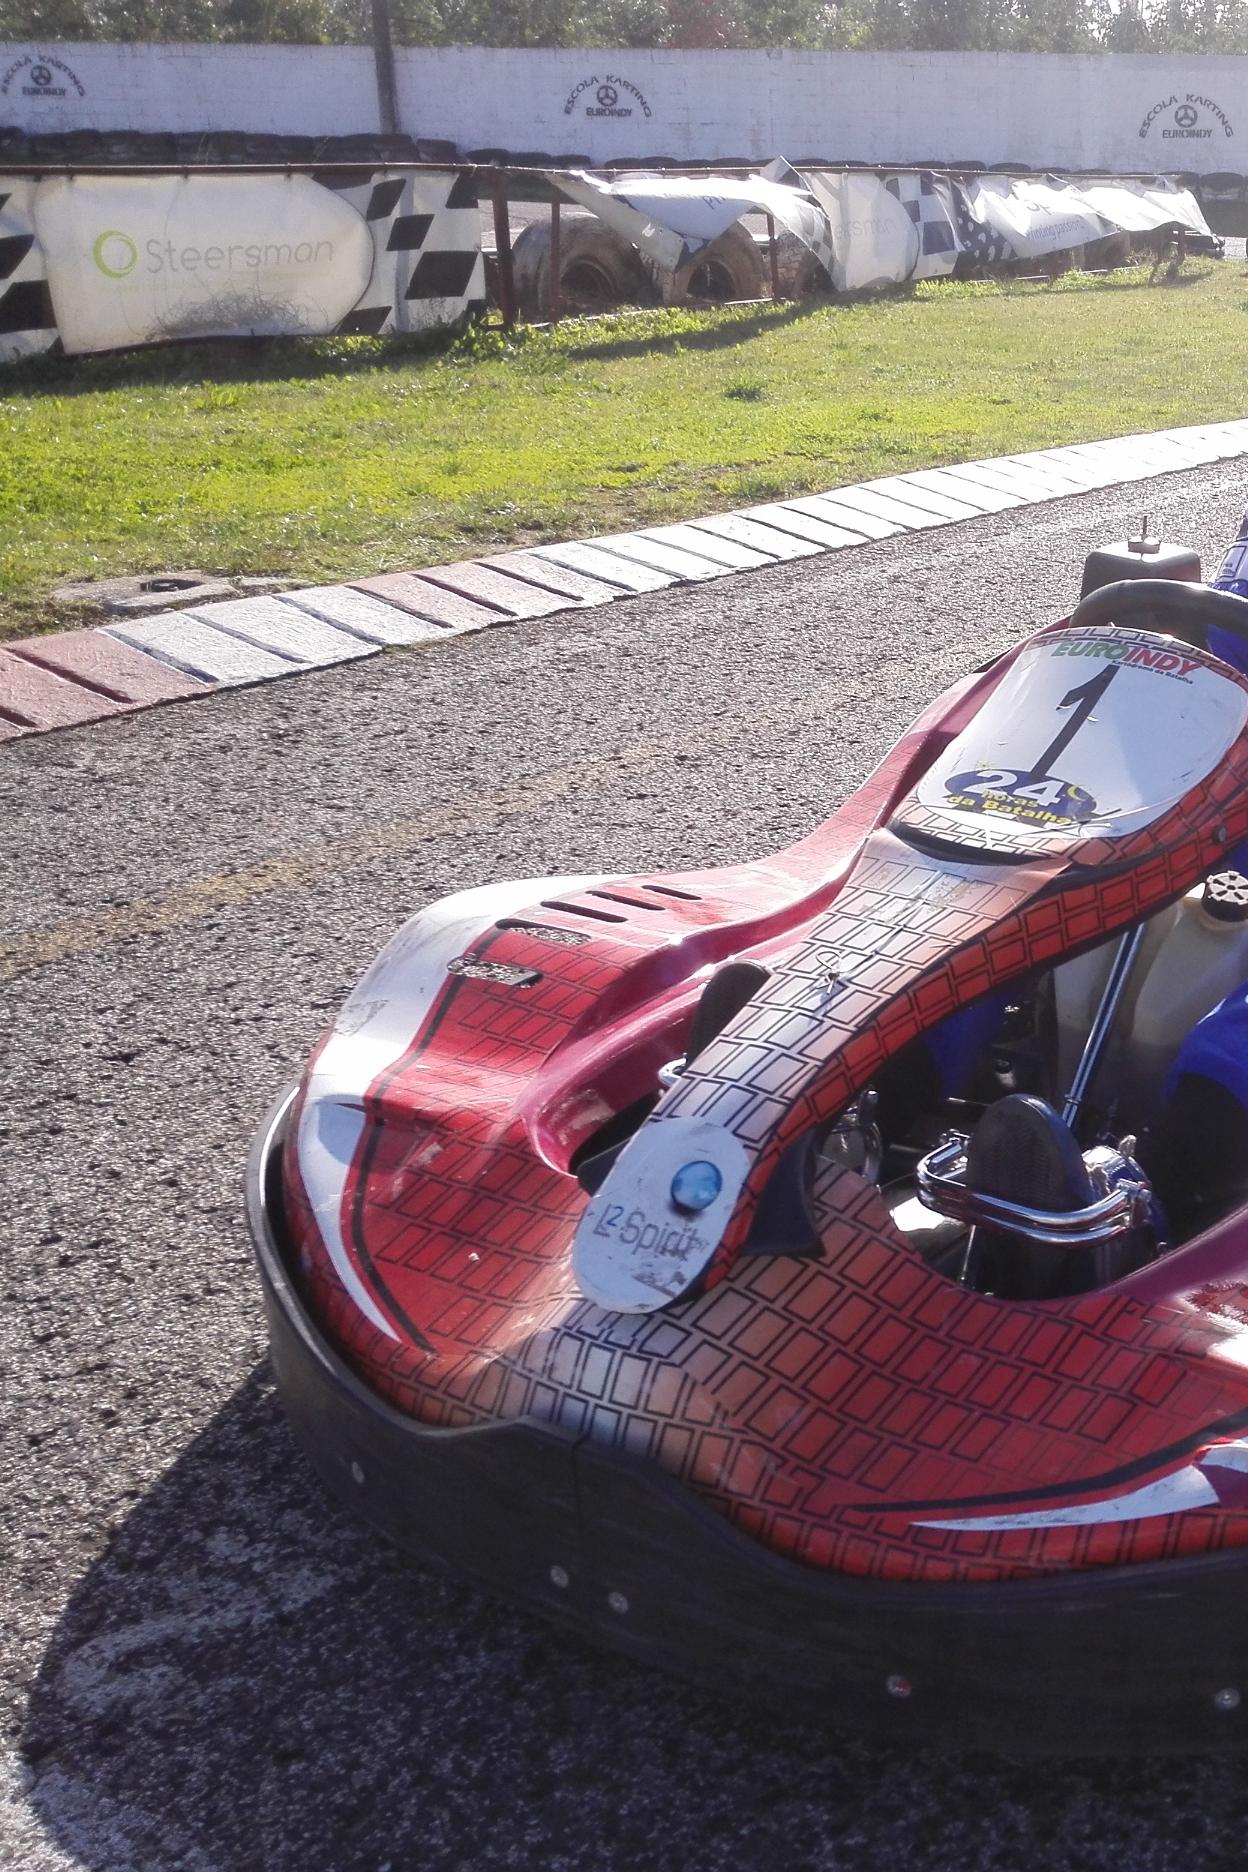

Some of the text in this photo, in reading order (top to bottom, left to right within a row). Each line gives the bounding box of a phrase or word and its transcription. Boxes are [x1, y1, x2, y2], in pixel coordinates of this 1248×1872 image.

[564, 74, 652, 117] ESCOLA KARTING
[586, 107, 632, 117] EUROINDY
[1139, 93, 1234, 138] ESCOLA KARTING
[1162, 129, 1213, 138] EUROINDY
[145, 239, 334, 274] Steersman
[1051, 640, 1203, 677] EUROINDY
[1031, 664, 1121, 778] 1
[962, 769, 1065, 807] 24
[980, 789, 1041, 808] horas
[947, 795, 1073, 826] da Batalha
